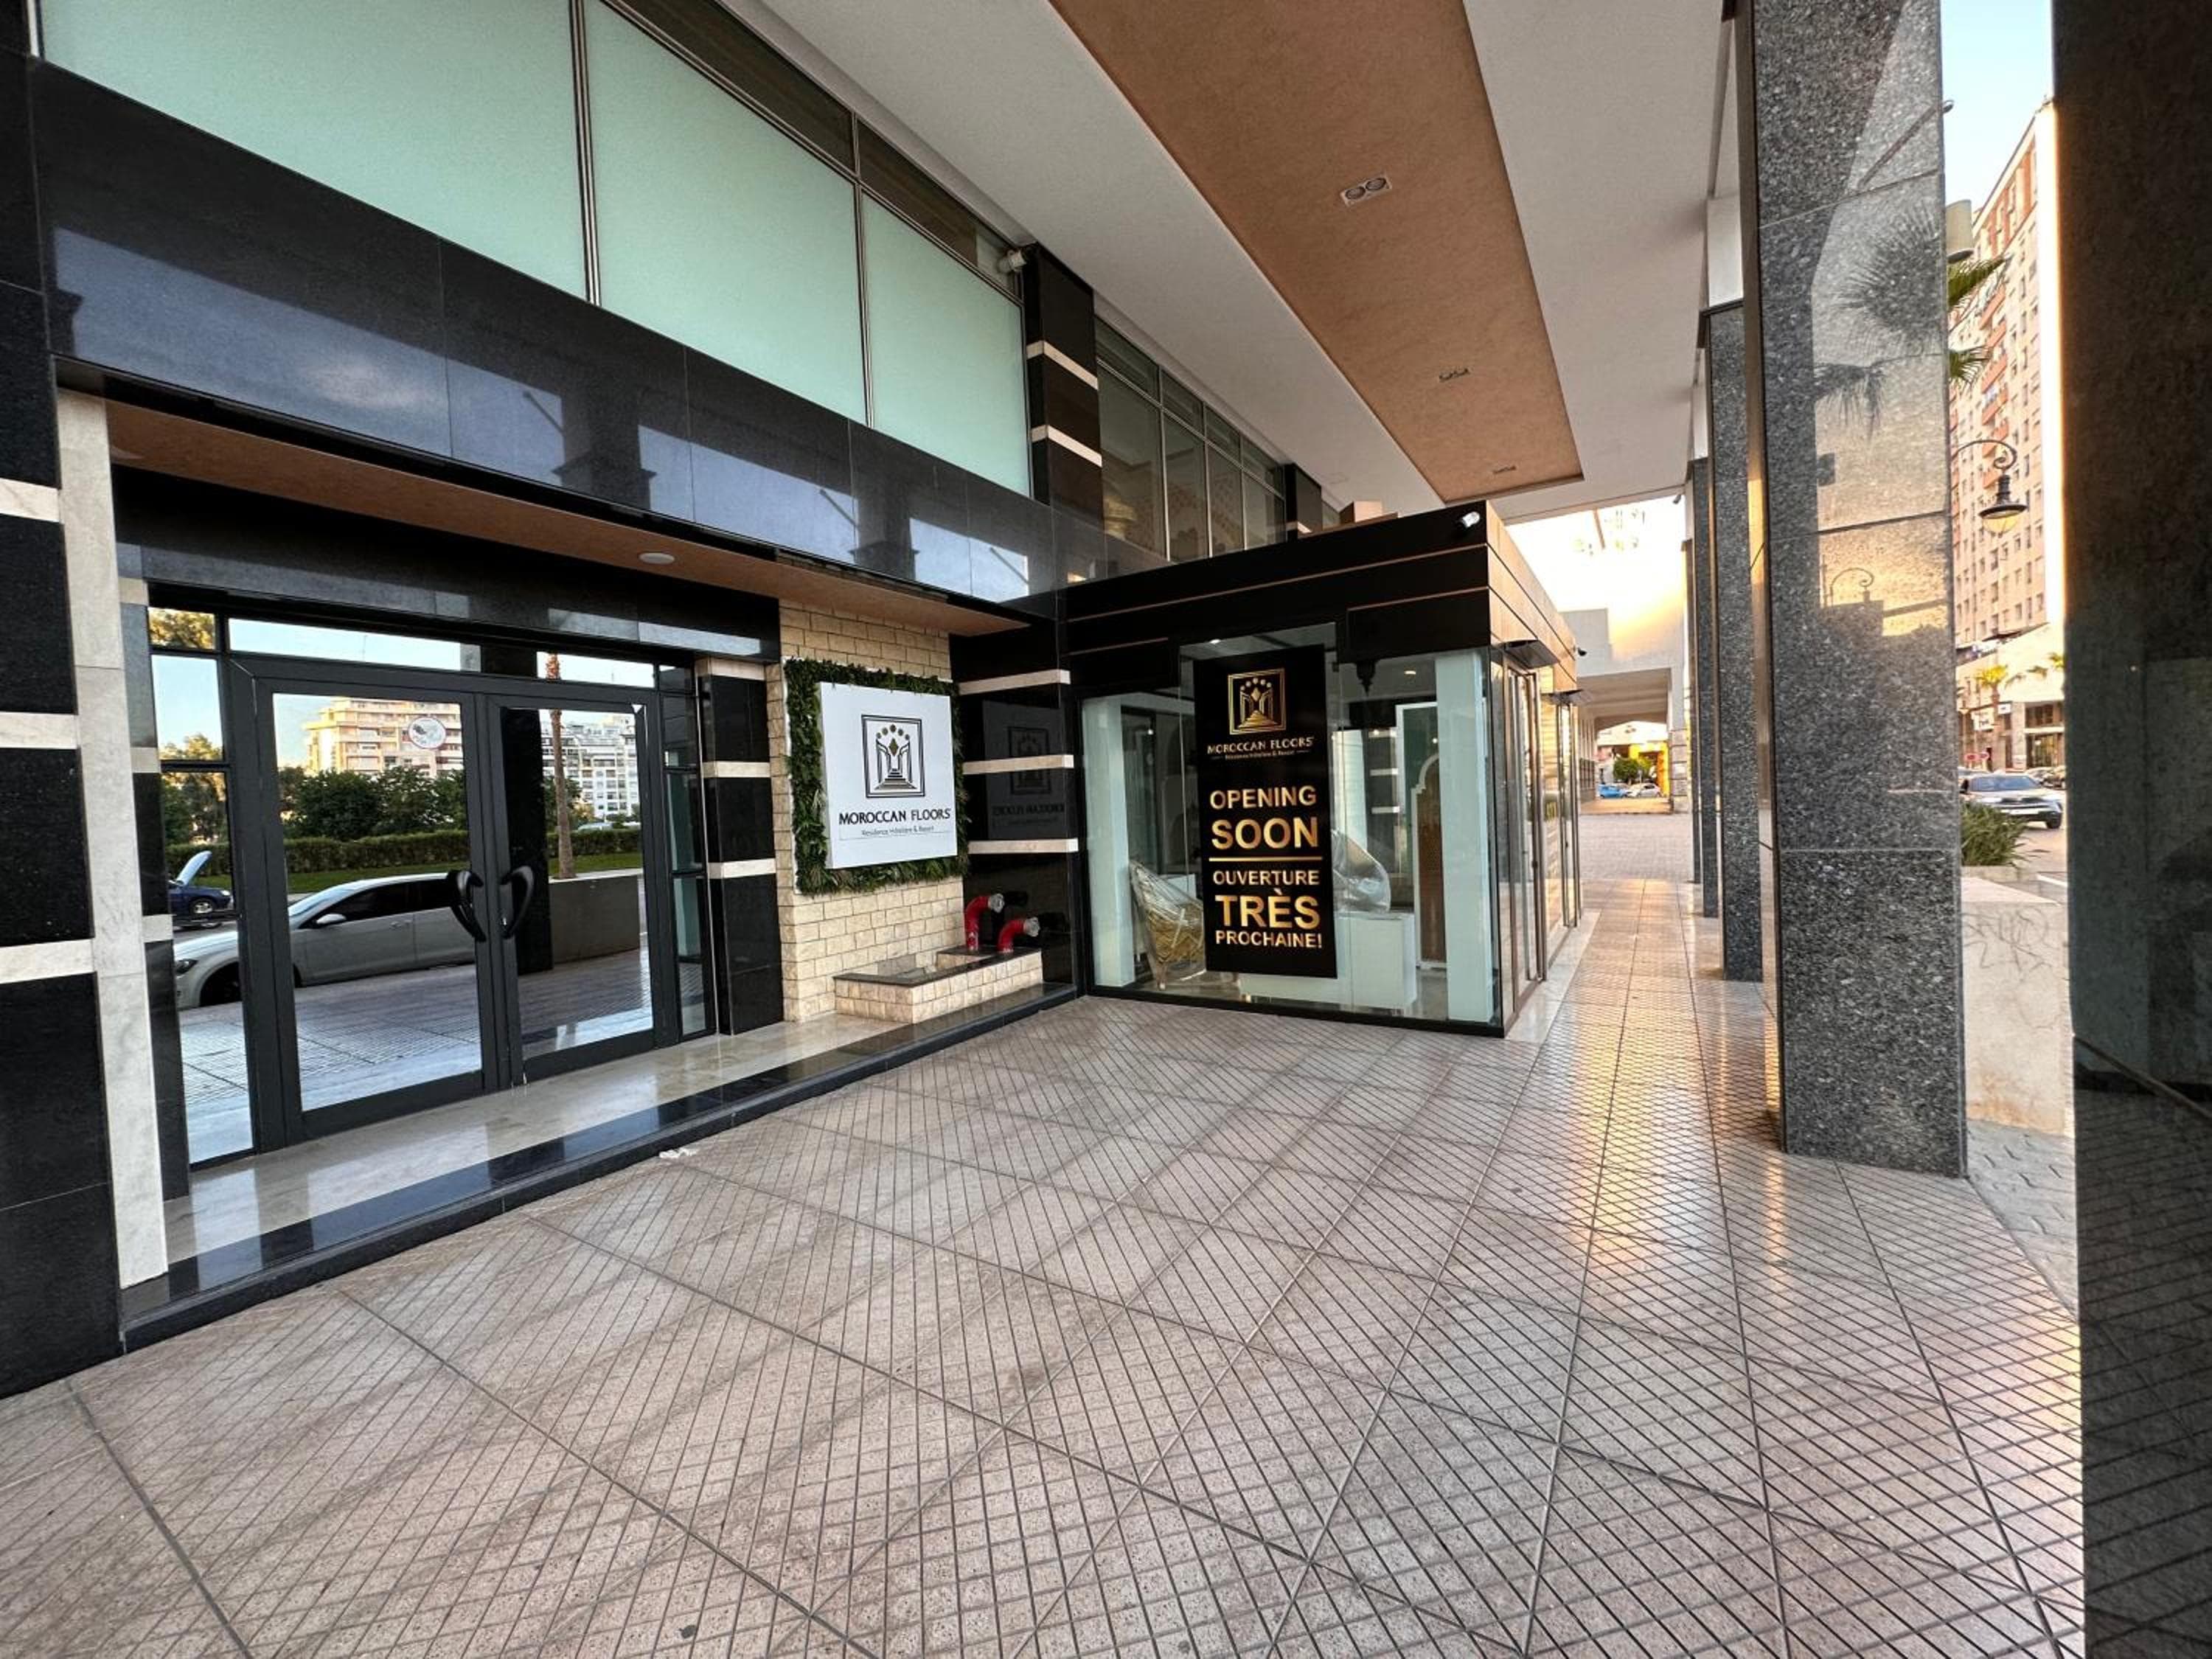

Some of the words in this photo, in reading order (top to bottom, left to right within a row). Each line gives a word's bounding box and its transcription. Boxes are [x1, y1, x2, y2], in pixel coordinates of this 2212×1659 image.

[1207, 740, 1266, 754] MOROCCAN
[1270, 737, 1313, 749] FLOORS
[1210, 785, 1317, 810] OPENING
[839, 810, 906, 825] MOROCCAN
[911, 808, 950, 821] FLOORS
[1211, 816, 1319, 849] SOON
[1213, 870, 1320, 886] OUVERTURE
[1214, 888, 1321, 930] TRÈS
[1216, 930, 1322, 949] PROCHAINE!
